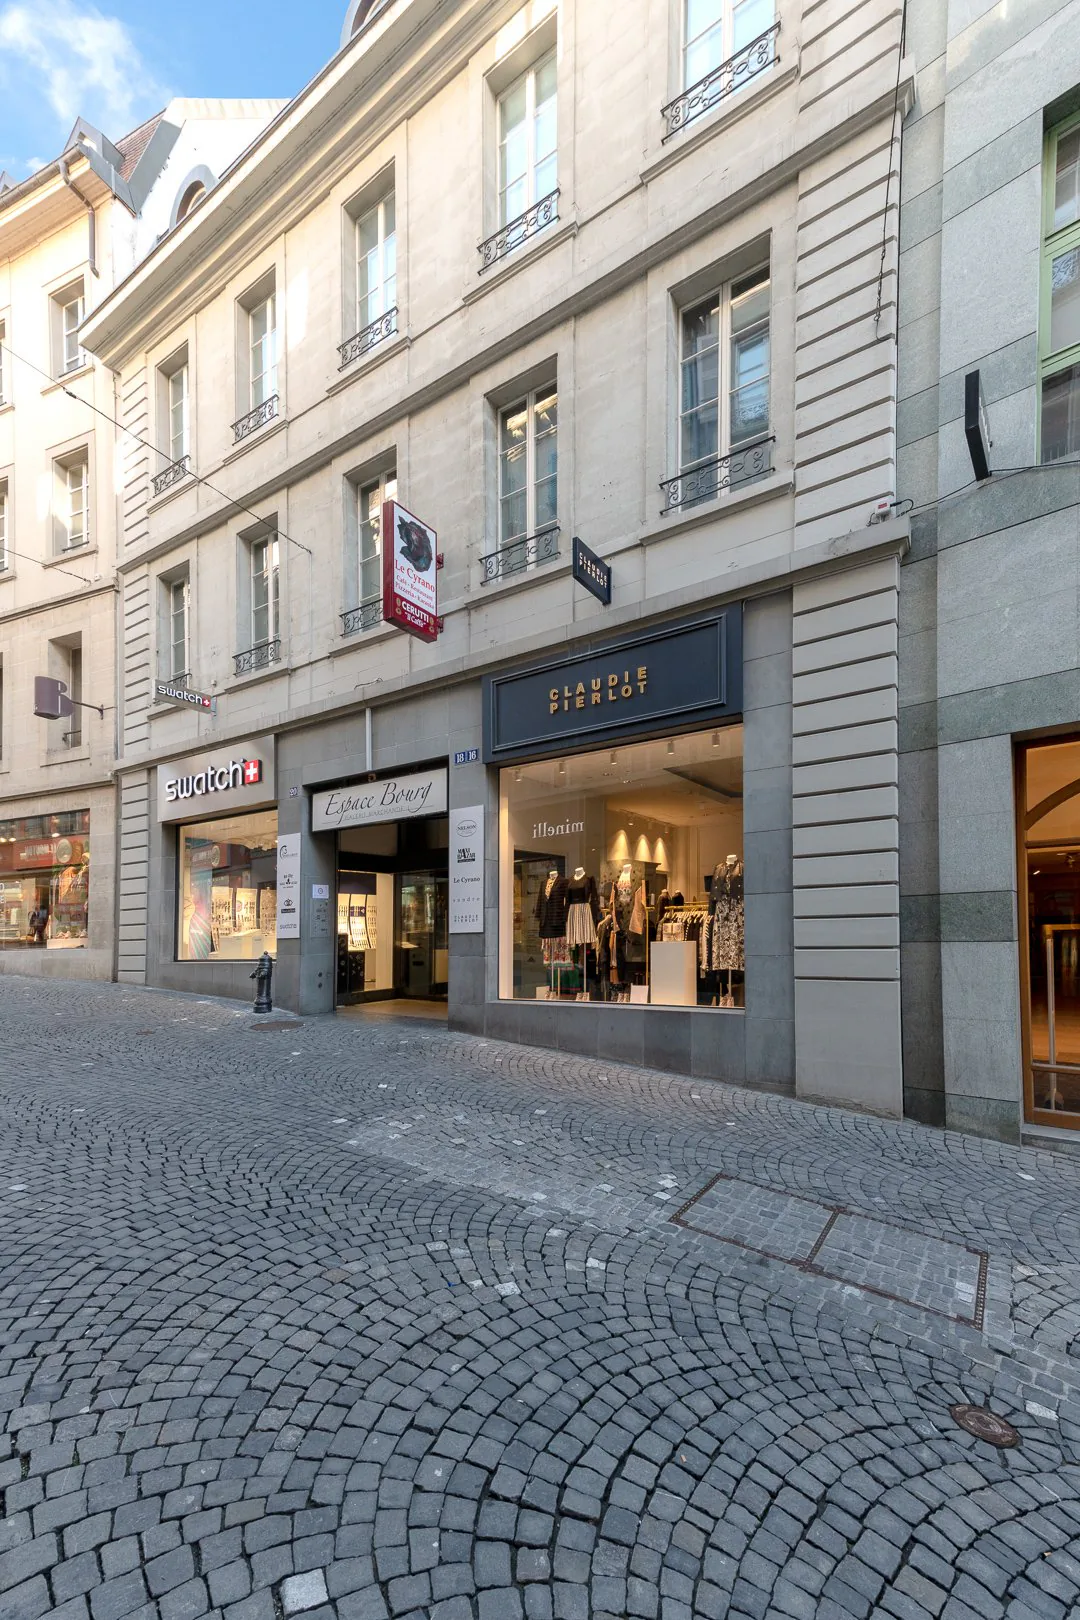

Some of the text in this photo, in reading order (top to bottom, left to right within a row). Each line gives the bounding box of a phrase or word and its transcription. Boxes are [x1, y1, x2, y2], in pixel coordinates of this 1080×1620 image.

[395, 559, 435, 593] Le Cyrano
[401, 601, 429, 623] CERUTTI
[158, 685, 203, 705] swatch
[549, 666, 647, 701] CLAUDIE
[549, 681, 647, 714] PIERLOT
[165, 760, 242, 802] swatch
[325, 781, 433, 825] Espace Bourg
[461, 876, 480, 884] Cyrano
